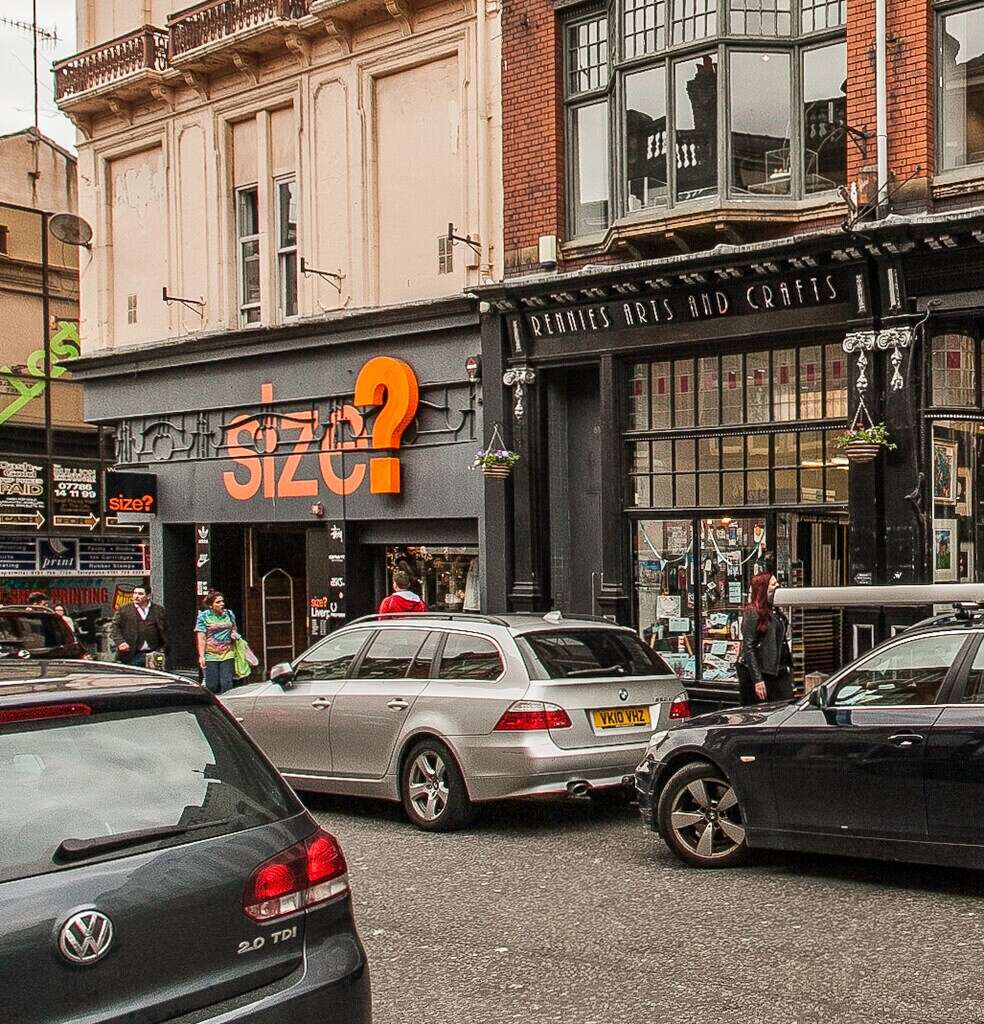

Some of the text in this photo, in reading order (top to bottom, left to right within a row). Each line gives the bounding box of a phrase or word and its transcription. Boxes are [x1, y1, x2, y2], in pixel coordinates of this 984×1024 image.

[530, 275, 838, 337] RENNIES ARTS AND CRAFTS
[223, 356, 420, 500] size?
[0, 483, 44, 495] PAID
[109, 494, 154, 511] size?
[42, 556, 74, 569] print
[51, 587, 108, 605] PRINTING
[311, 597, 328, 607] size?
[600, 710, 646, 725] VK10 VHZ
[237, 927, 298, 955] 2.0 TDI
